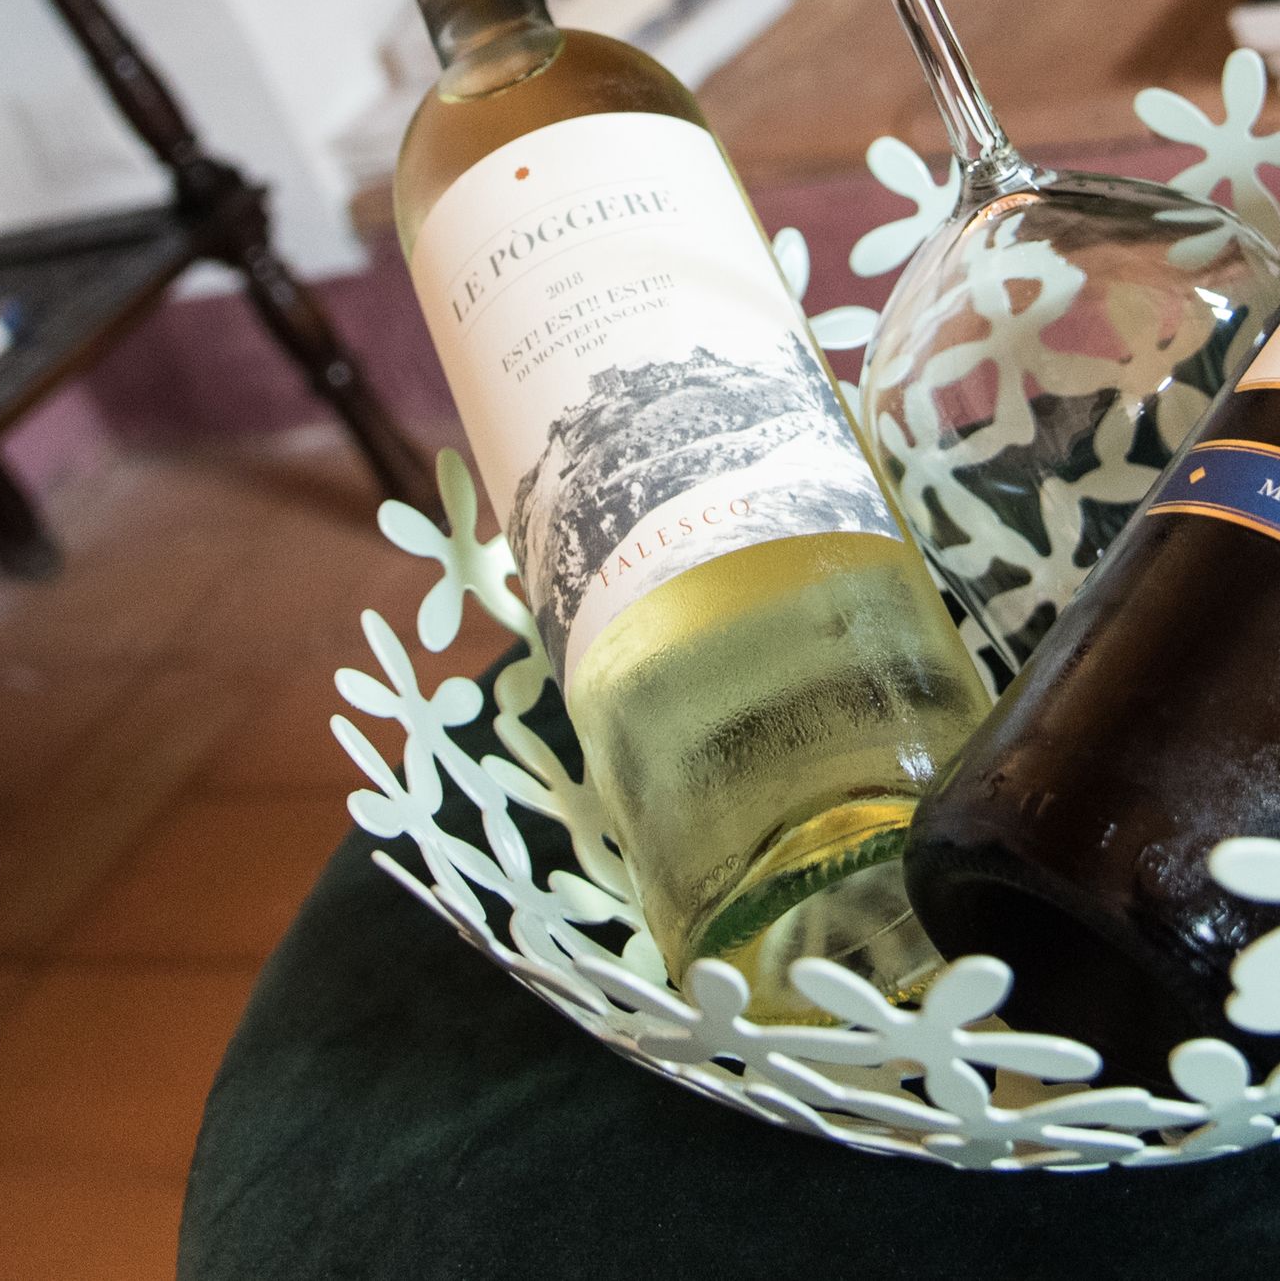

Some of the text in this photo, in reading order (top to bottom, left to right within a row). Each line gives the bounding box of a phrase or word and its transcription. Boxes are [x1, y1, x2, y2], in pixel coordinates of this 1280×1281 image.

[452, 190, 678, 324] LE PÒGGERE
[544, 271, 585, 300] 2018
[501, 273, 676, 374] EST! EST!! EST!!!
[515, 297, 671, 384] DI MONTEFIASCONE
[574, 333, 609, 358] DOP
[598, 497, 751, 588] FALESCO
